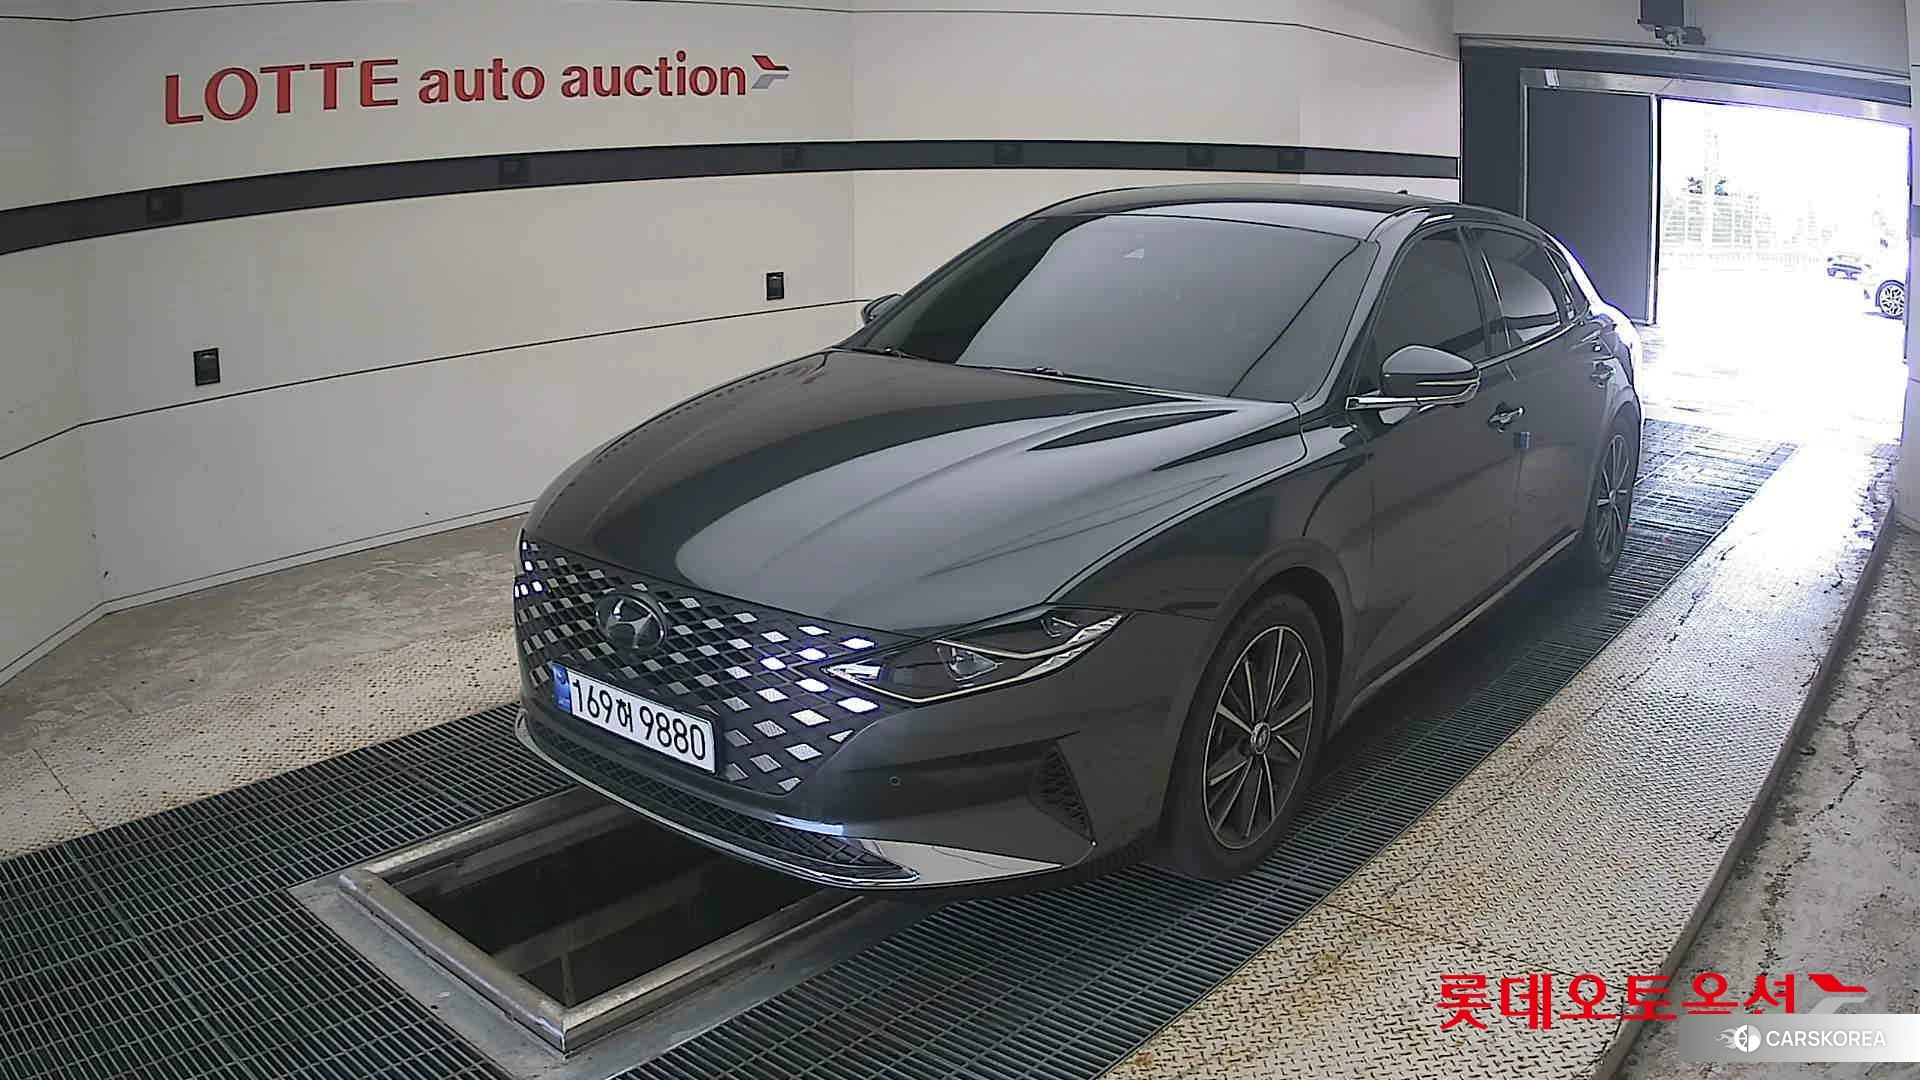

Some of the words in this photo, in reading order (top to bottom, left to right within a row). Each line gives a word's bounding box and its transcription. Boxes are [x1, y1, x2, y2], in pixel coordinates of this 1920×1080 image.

[164, 59, 399, 125] LOTTE
[418, 57, 546, 104] auto
[561, 50, 747, 98] auction
[572, 678, 634, 733] 169허
[639, 705, 706, 761] 9880
